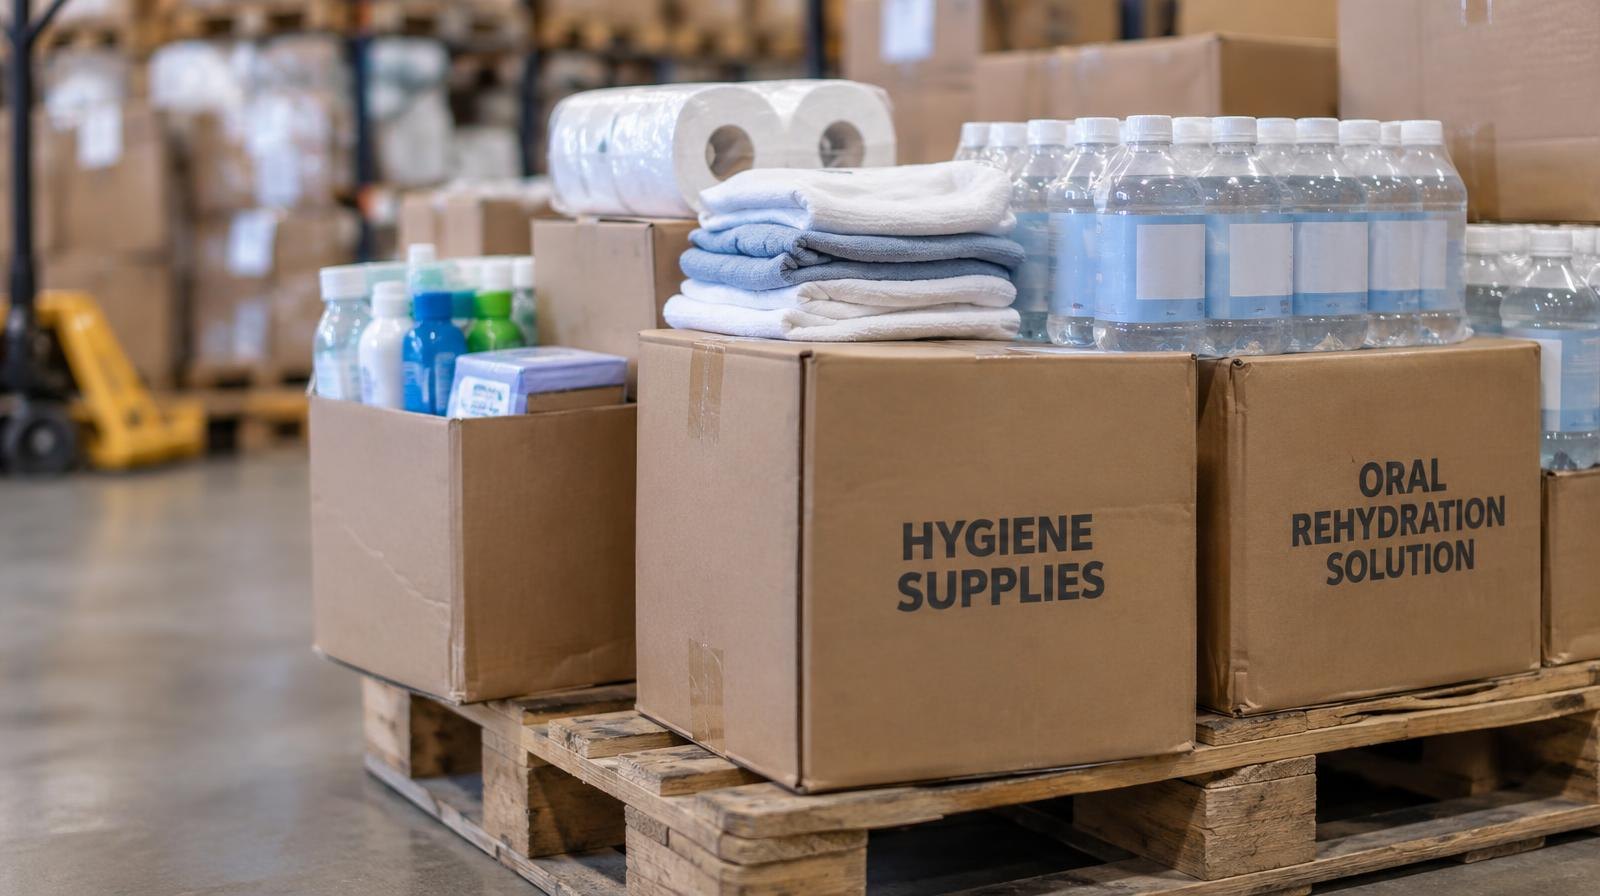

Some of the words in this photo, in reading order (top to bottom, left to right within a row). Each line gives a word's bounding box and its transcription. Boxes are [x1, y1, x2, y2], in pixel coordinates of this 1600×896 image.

[1358, 457, 1448, 499] ORAL
[902, 513, 1094, 562] HYGIENE
[1291, 494, 1507, 549] REHYDRATION
[897, 560, 1106, 613] SUPPLIES
[1325, 537, 1475, 587] SOLUTION
